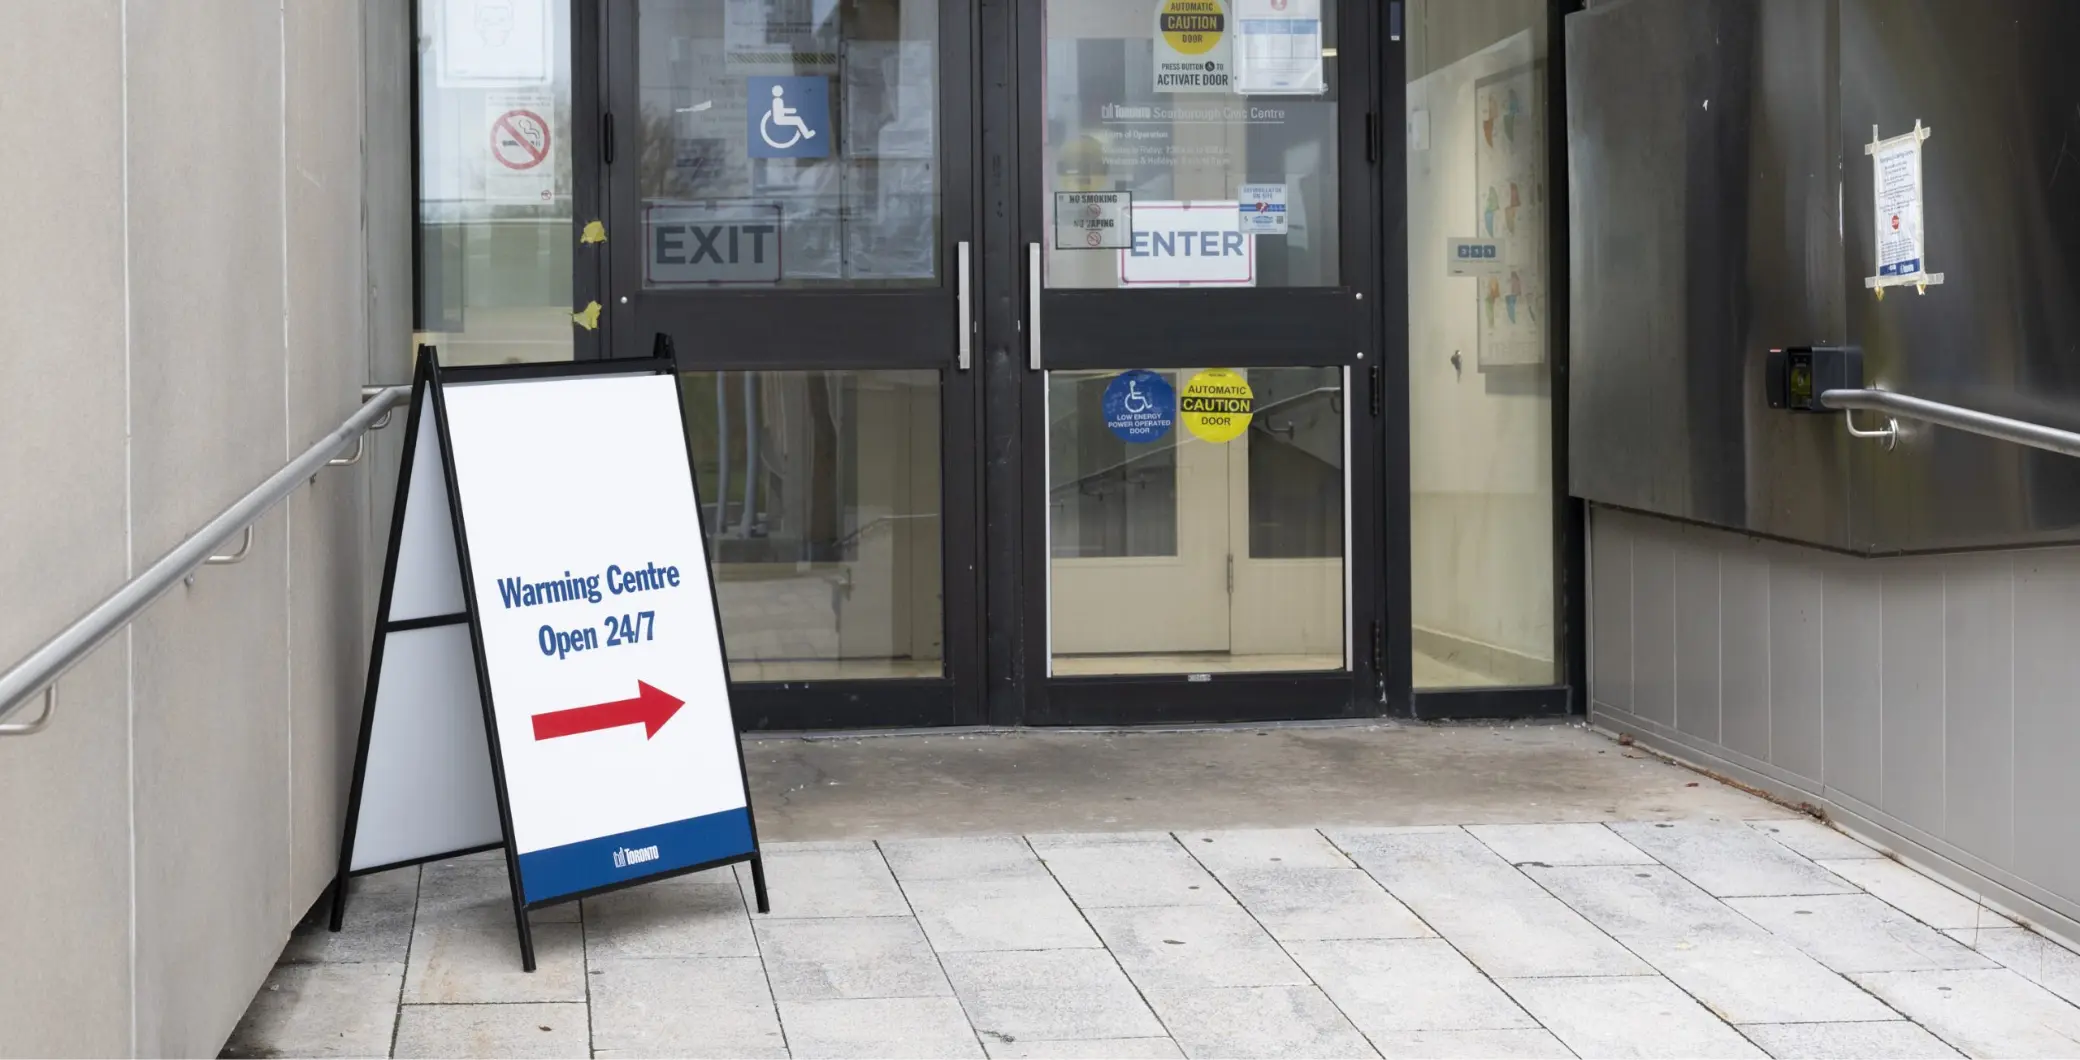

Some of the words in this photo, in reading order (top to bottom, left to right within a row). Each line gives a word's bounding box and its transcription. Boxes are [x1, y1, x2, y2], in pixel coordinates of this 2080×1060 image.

[1170, 1, 1214, 12] AUTOMATIC
[1167, 16, 1217, 30] CAUTION
[1182, 34, 1203, 44] DOOR
[1161, 63, 1181, 71] PRESS
[1181, 63, 1204, 71] BUTTON
[1216, 63, 1224, 71] TO
[1157, 74, 1201, 86] ACTIVATE
[1202, 74, 1229, 86] DOOR
[1153, 107, 1222, 121] Scarborough
[1250, 107, 1285, 119] Centre
[1069, 195, 1080, 203] NO
[1081, 194, 1118, 203] SMOKING
[656, 225, 774, 264] EXIT
[1131, 231, 1244, 257] ENTER
[1188, 385, 1247, 395] AUTOMATIC
[1183, 398, 1250, 412] CAUTION
[1201, 417, 1231, 426] DOOR
[497, 570, 603, 609] Warming
[606, 561, 681, 595] Centre
[538, 624, 599, 660] Open
[603, 610, 655, 647] 24/7
[624, 845, 660, 865] TORONTO
